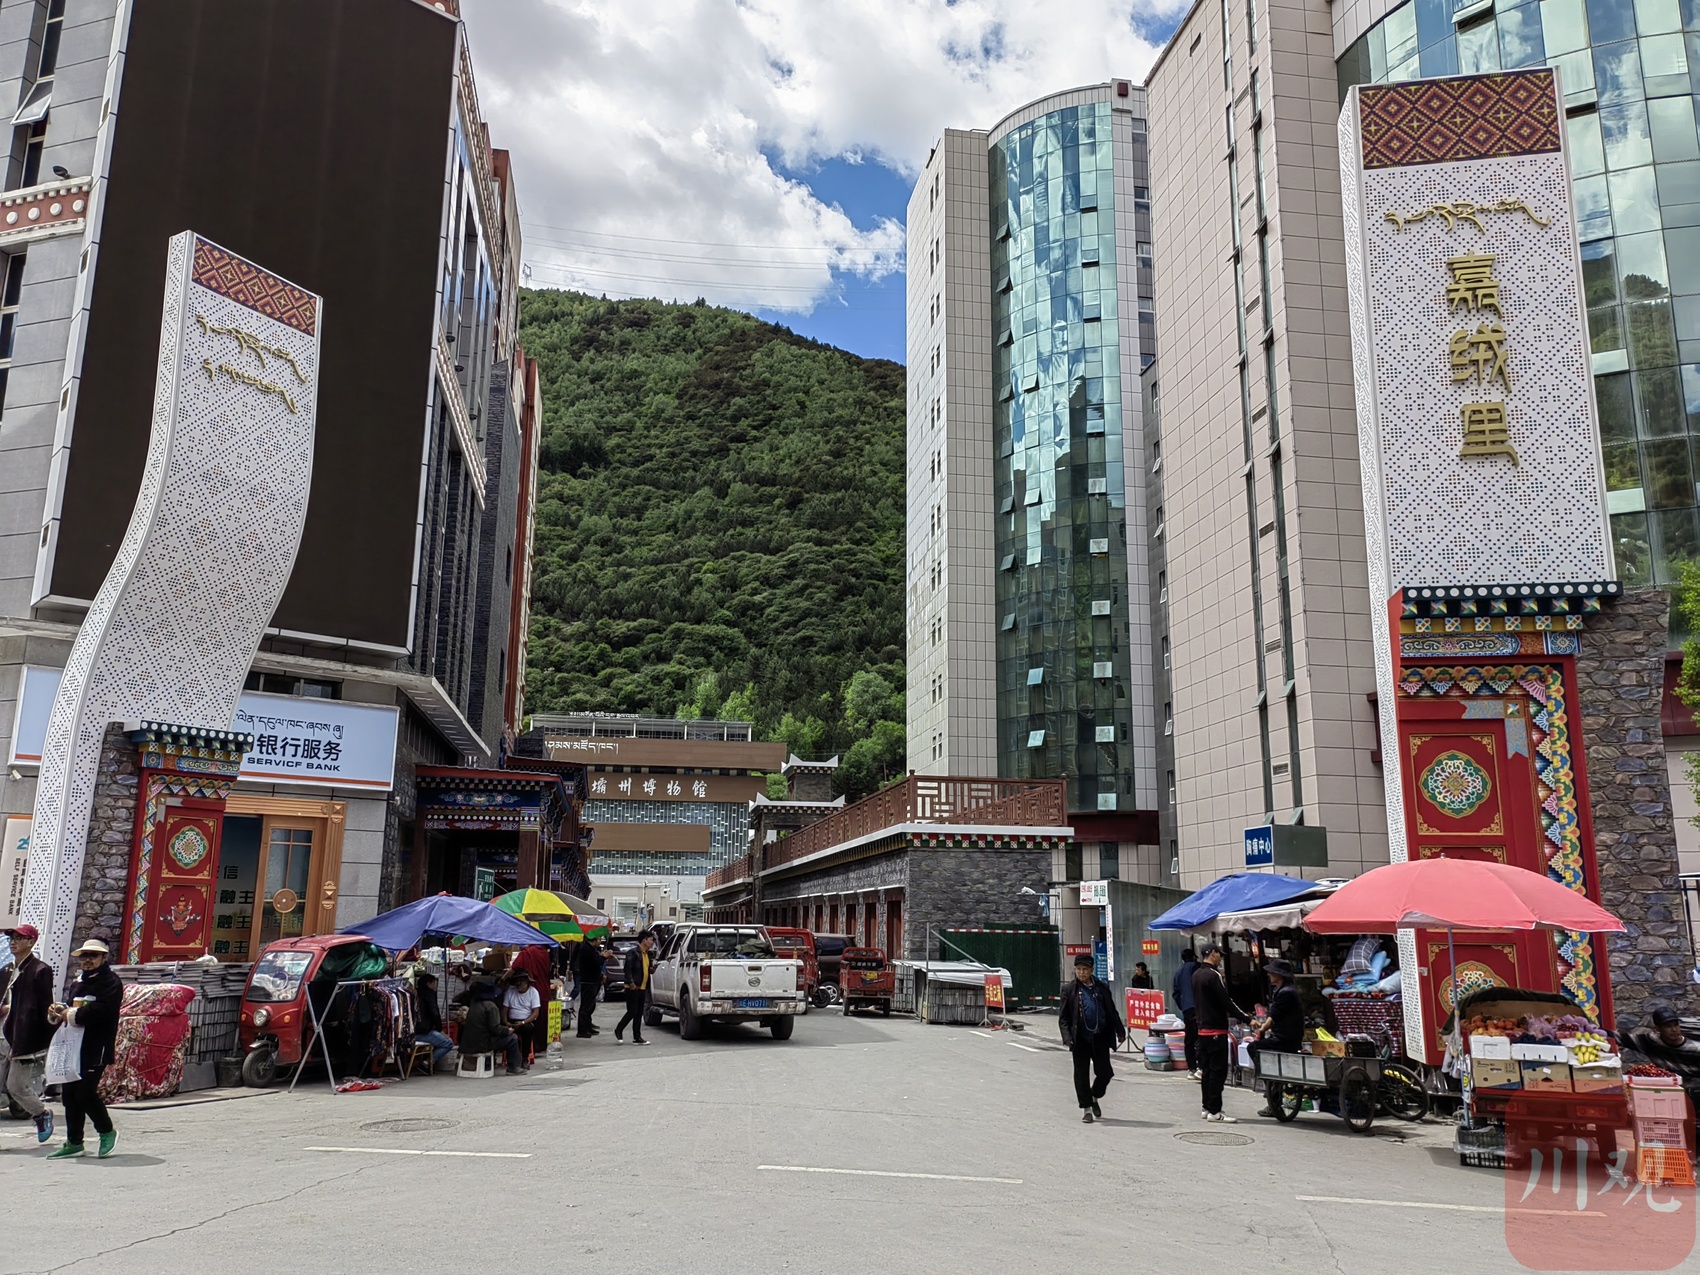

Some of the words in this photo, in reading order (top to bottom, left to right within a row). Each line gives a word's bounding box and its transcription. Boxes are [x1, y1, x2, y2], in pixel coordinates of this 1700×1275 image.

[1446, 250, 1520, 468] 嘉绒里
[248, 732, 342, 761] 银行服务
[306, 762, 341, 772] BANK
[1246, 837, 1272, 856] 胸痛中心
[10, 874, 19, 897] SERVICE
